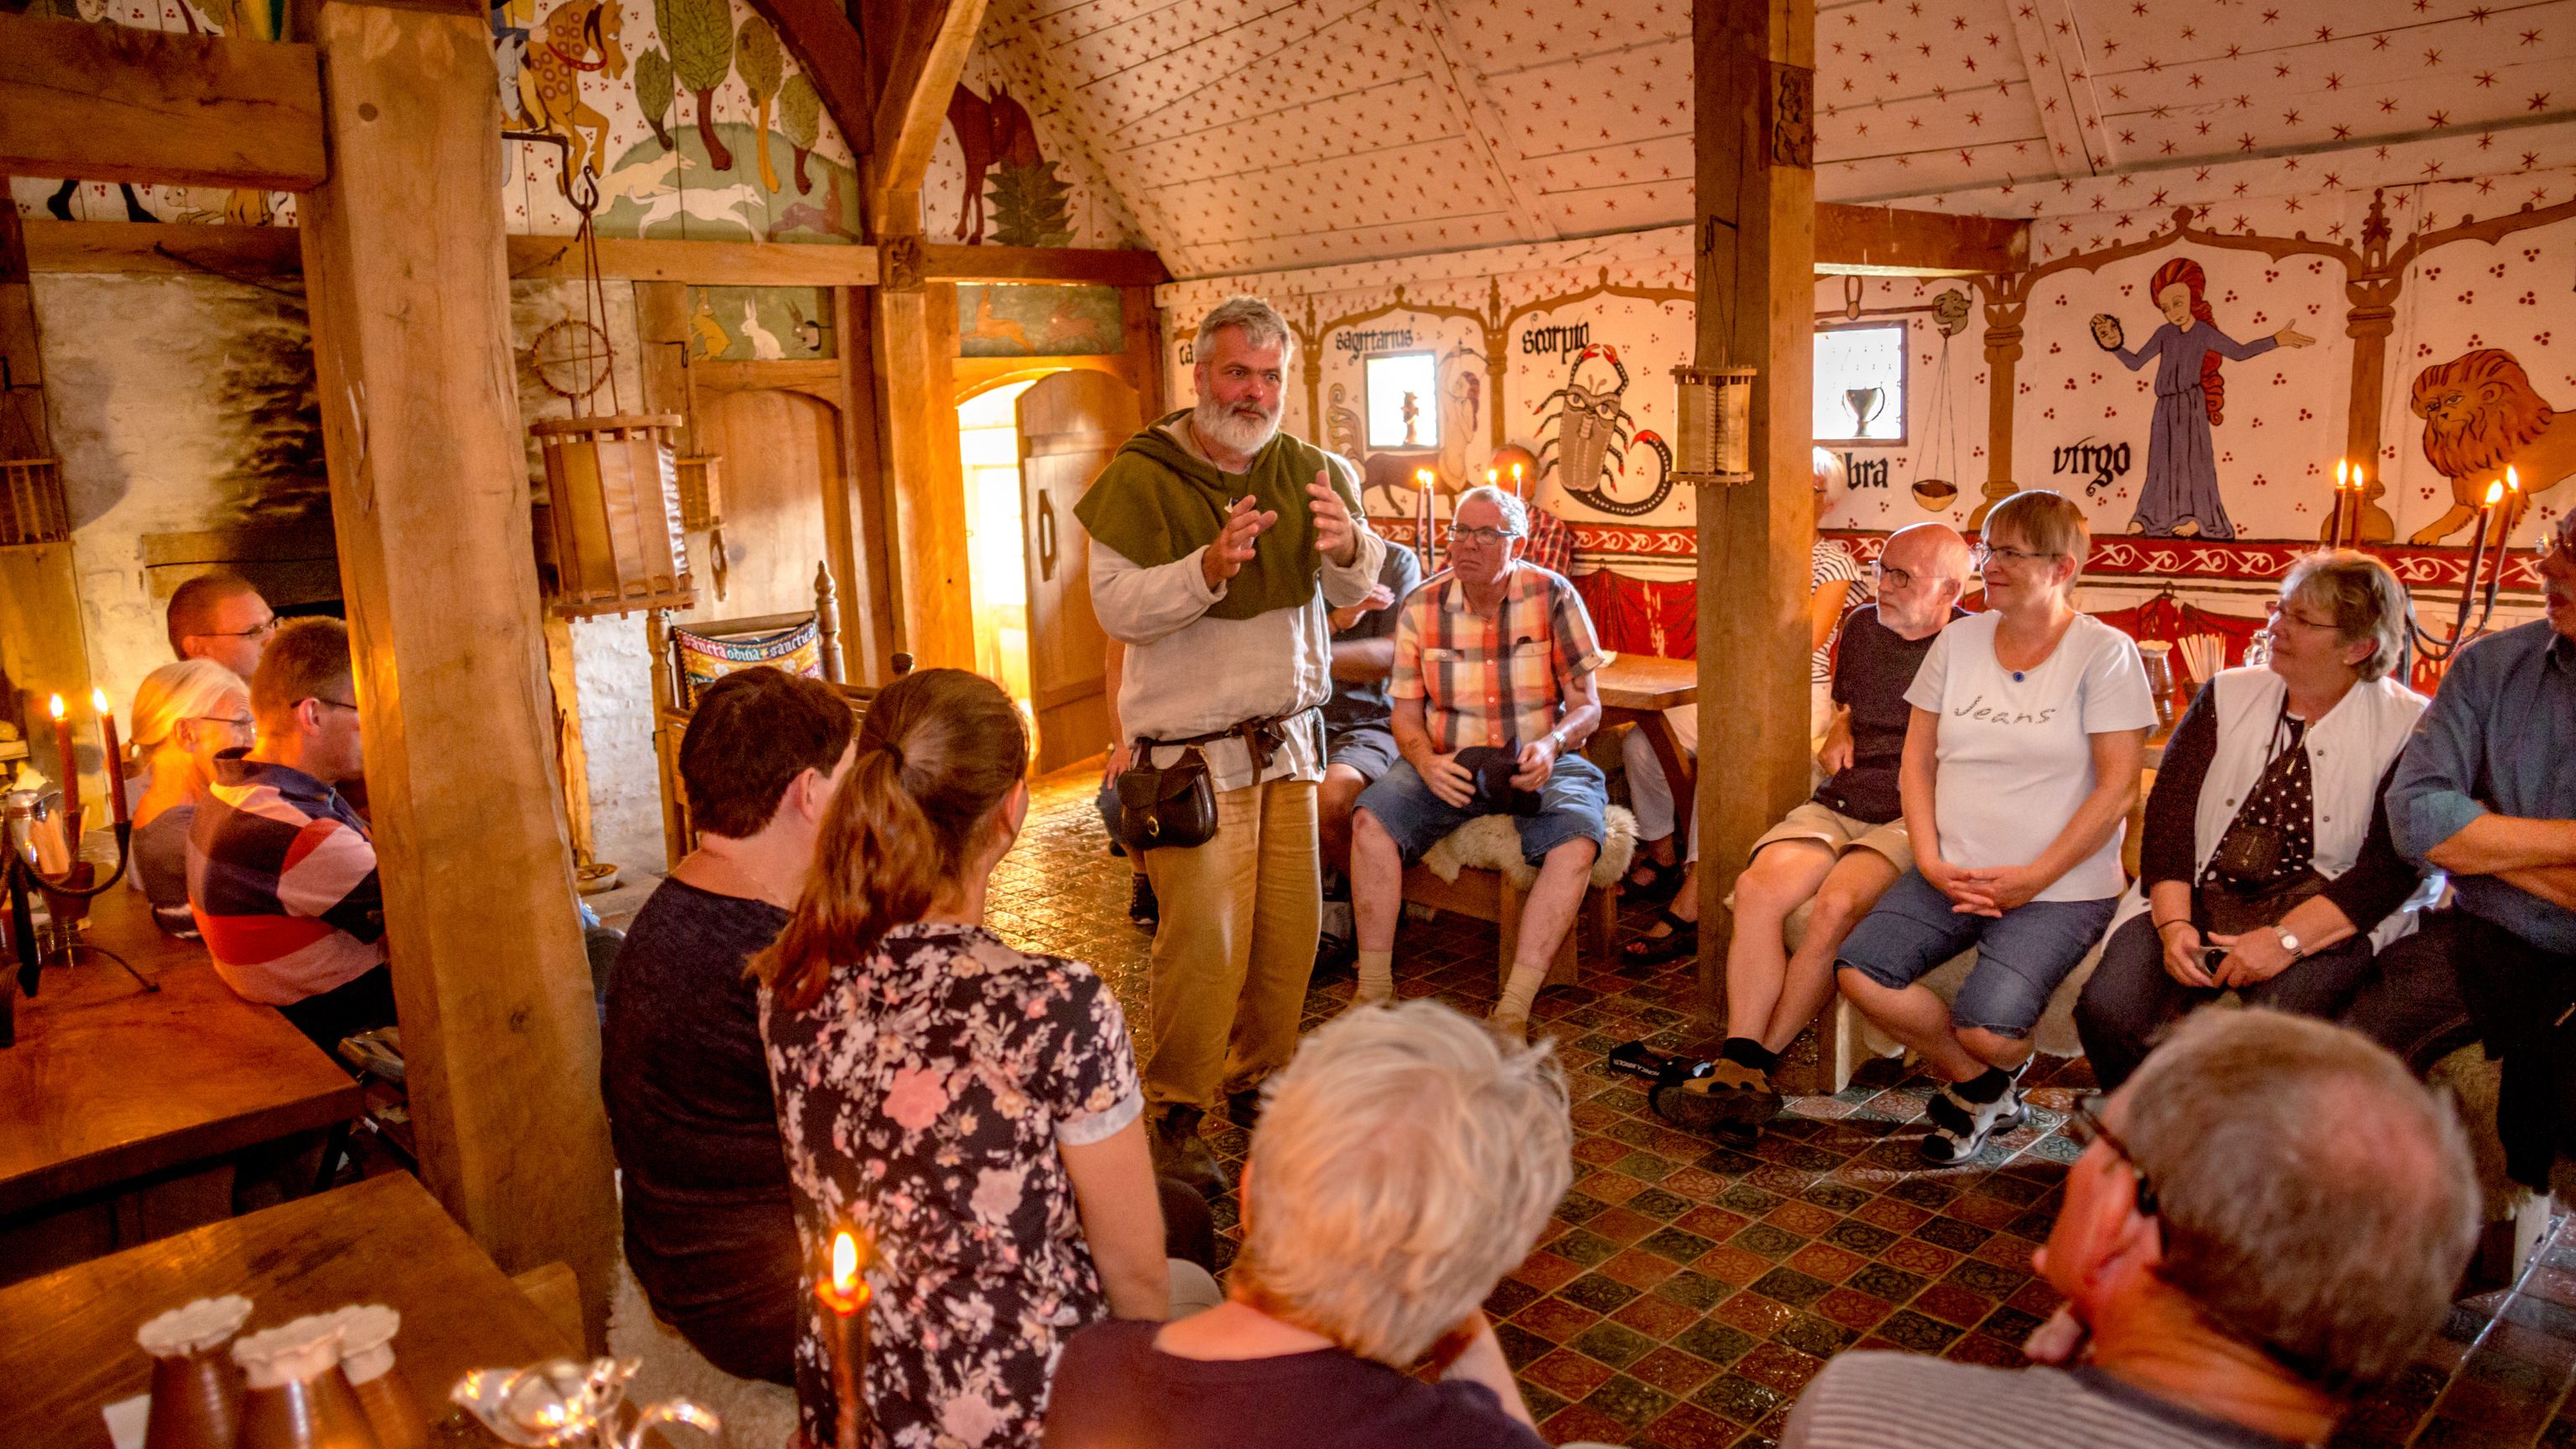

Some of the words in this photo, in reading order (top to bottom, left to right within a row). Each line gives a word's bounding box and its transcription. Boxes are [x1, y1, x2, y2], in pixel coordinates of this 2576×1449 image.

[1522, 320, 1590, 365] scorpio
[1844, 452, 1888, 491] bra
[2053, 435, 2131, 497] virgo
[1954, 695, 2056, 725] Jeans
